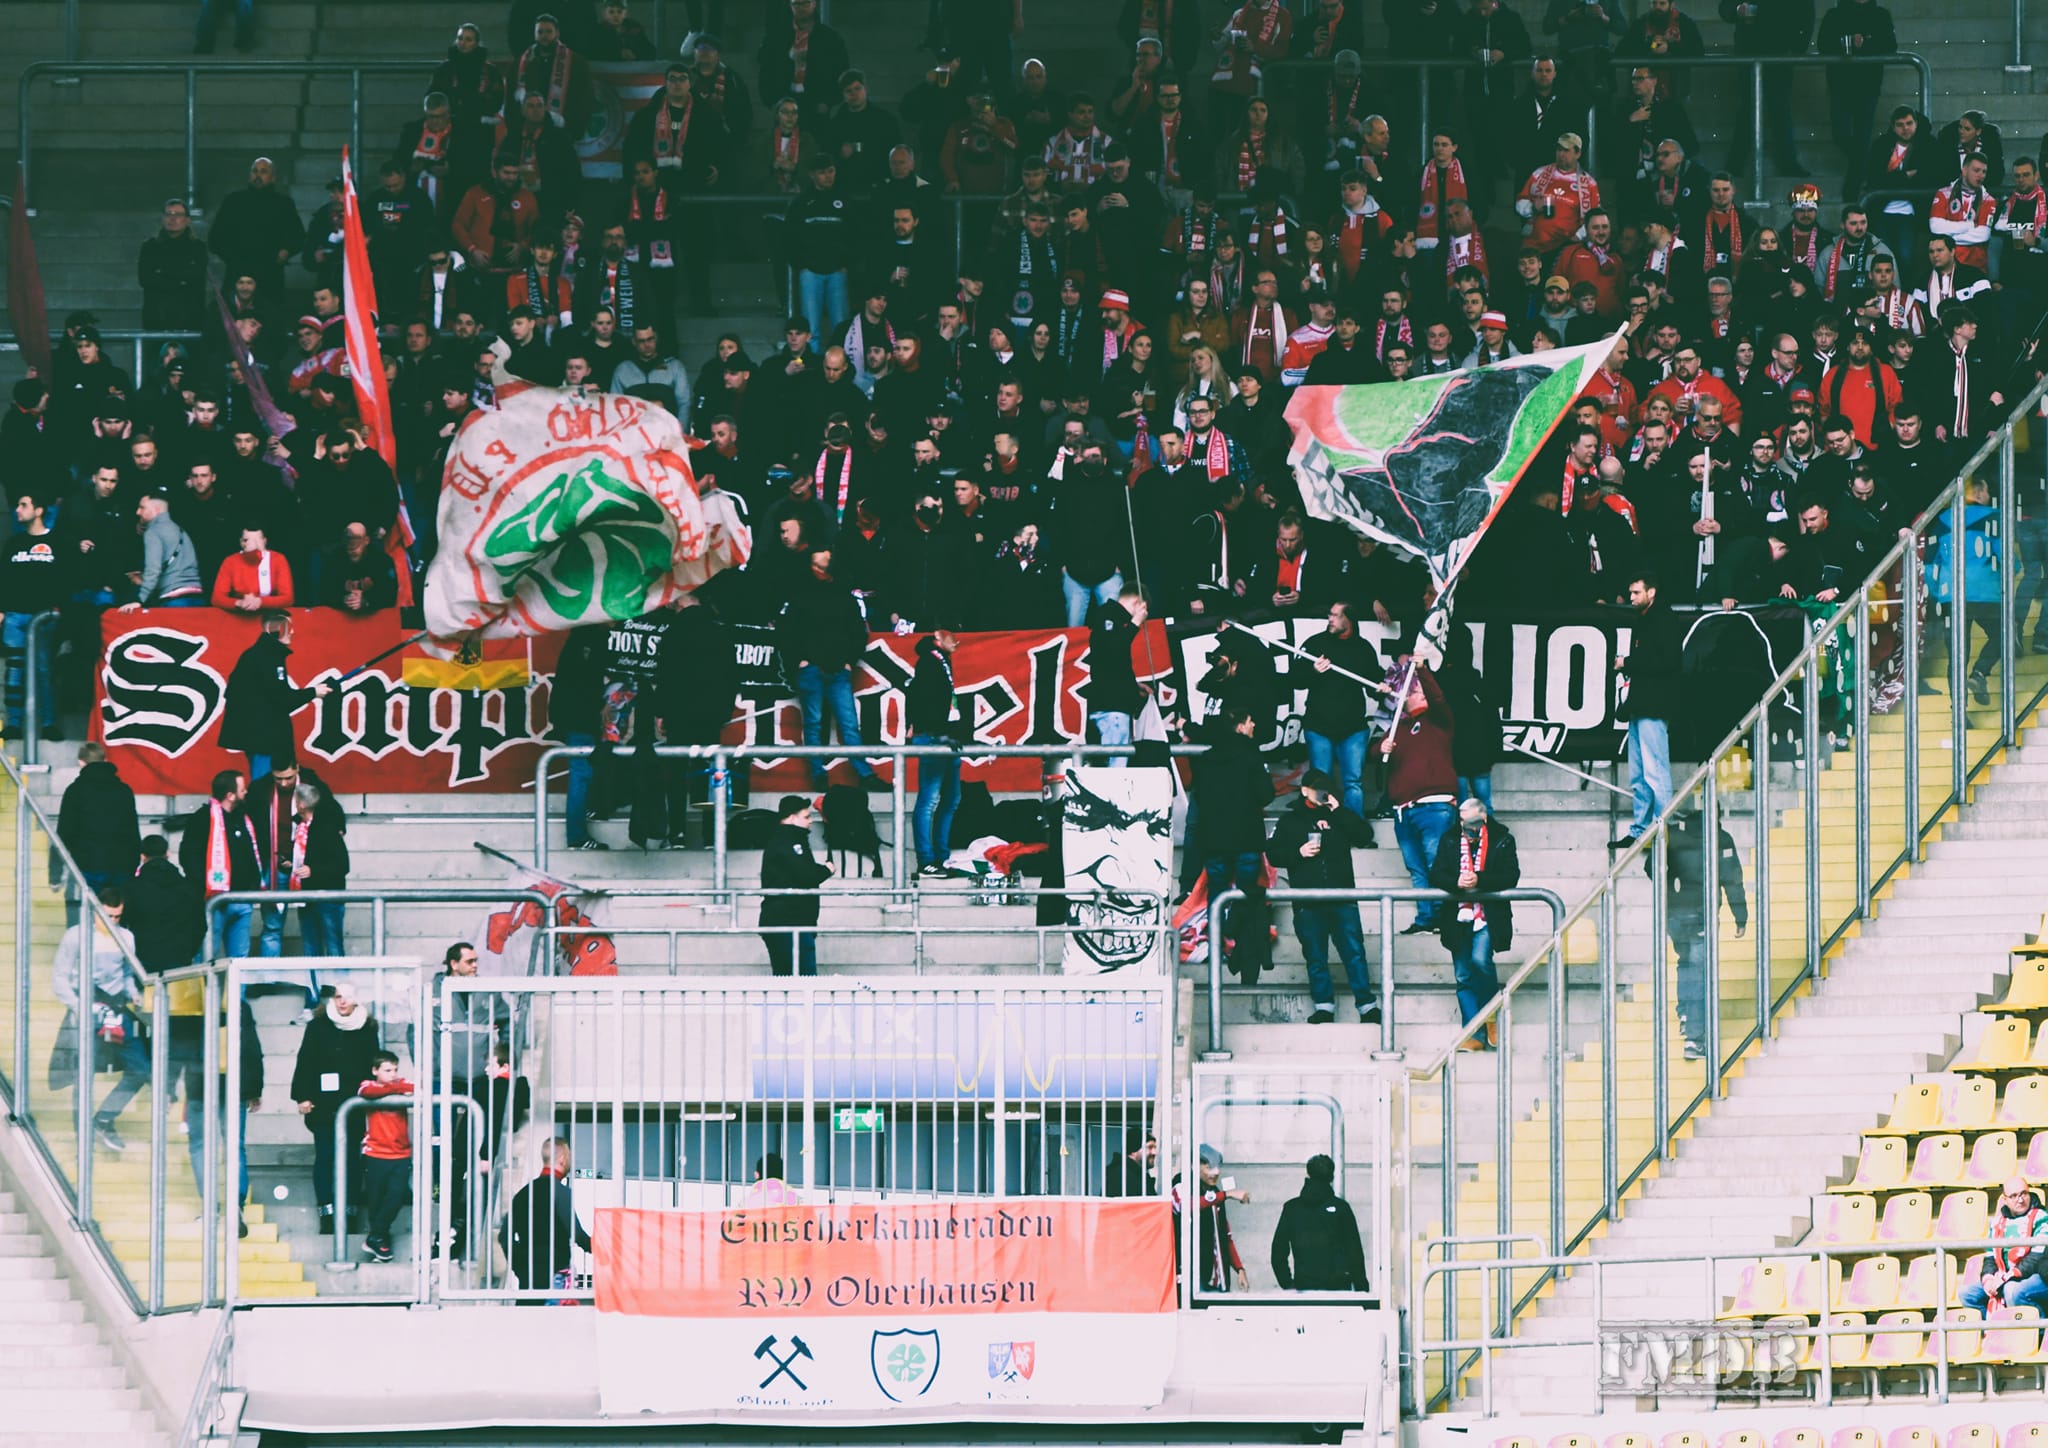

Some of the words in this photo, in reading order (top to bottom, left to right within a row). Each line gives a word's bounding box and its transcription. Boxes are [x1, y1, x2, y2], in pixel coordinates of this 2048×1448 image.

[720, 1209, 1053, 1246] Emscherkameraden
[738, 1276, 812, 1309] RW
[826, 1276, 1036, 1309] Oberhausen
